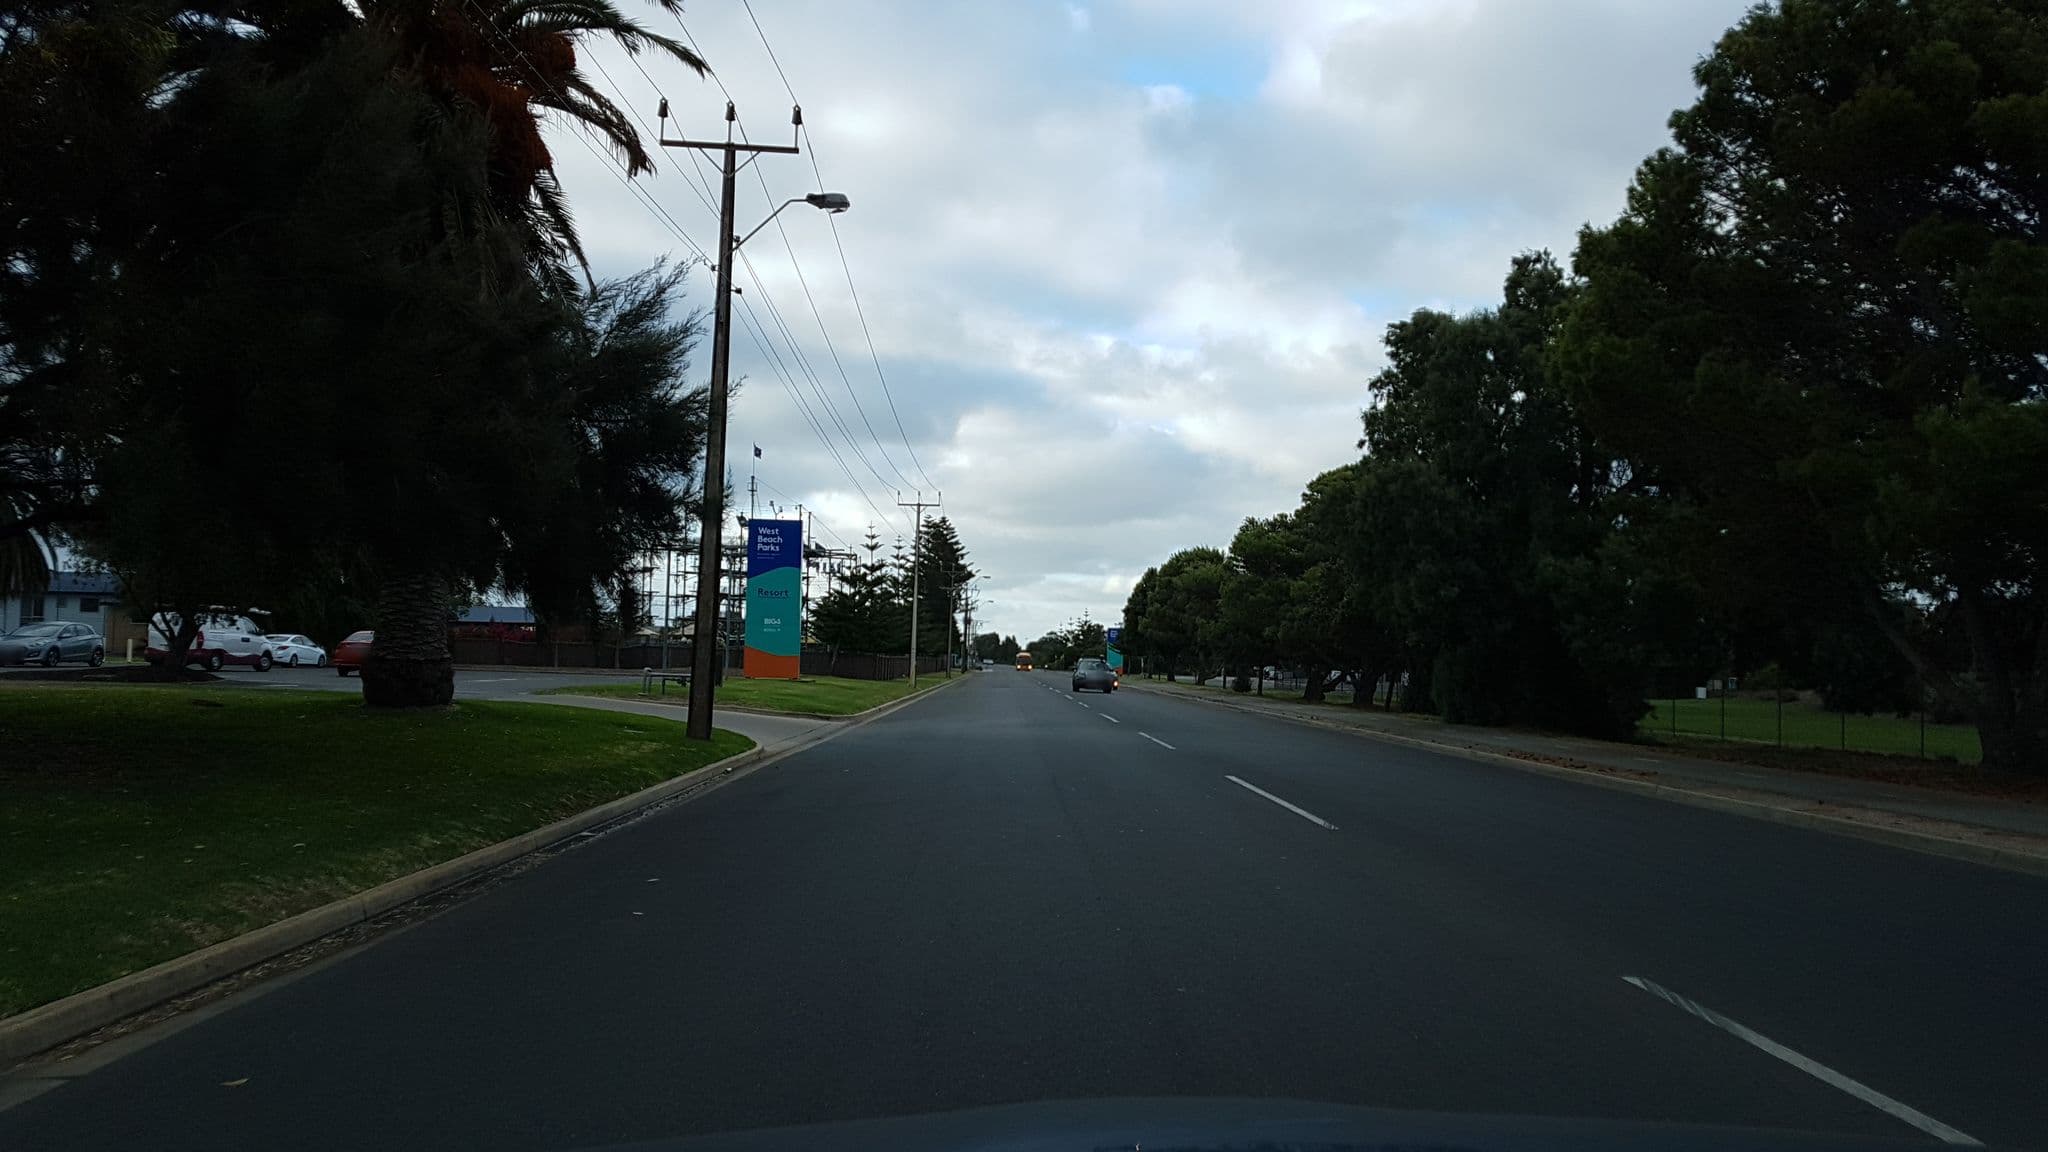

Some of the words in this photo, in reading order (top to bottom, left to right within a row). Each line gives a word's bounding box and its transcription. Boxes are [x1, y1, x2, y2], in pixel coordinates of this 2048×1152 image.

[758, 527, 779, 535] West
[757, 535, 783, 543] Beach
[757, 543, 780, 551] Parks
[757, 587, 789, 597] Resort
